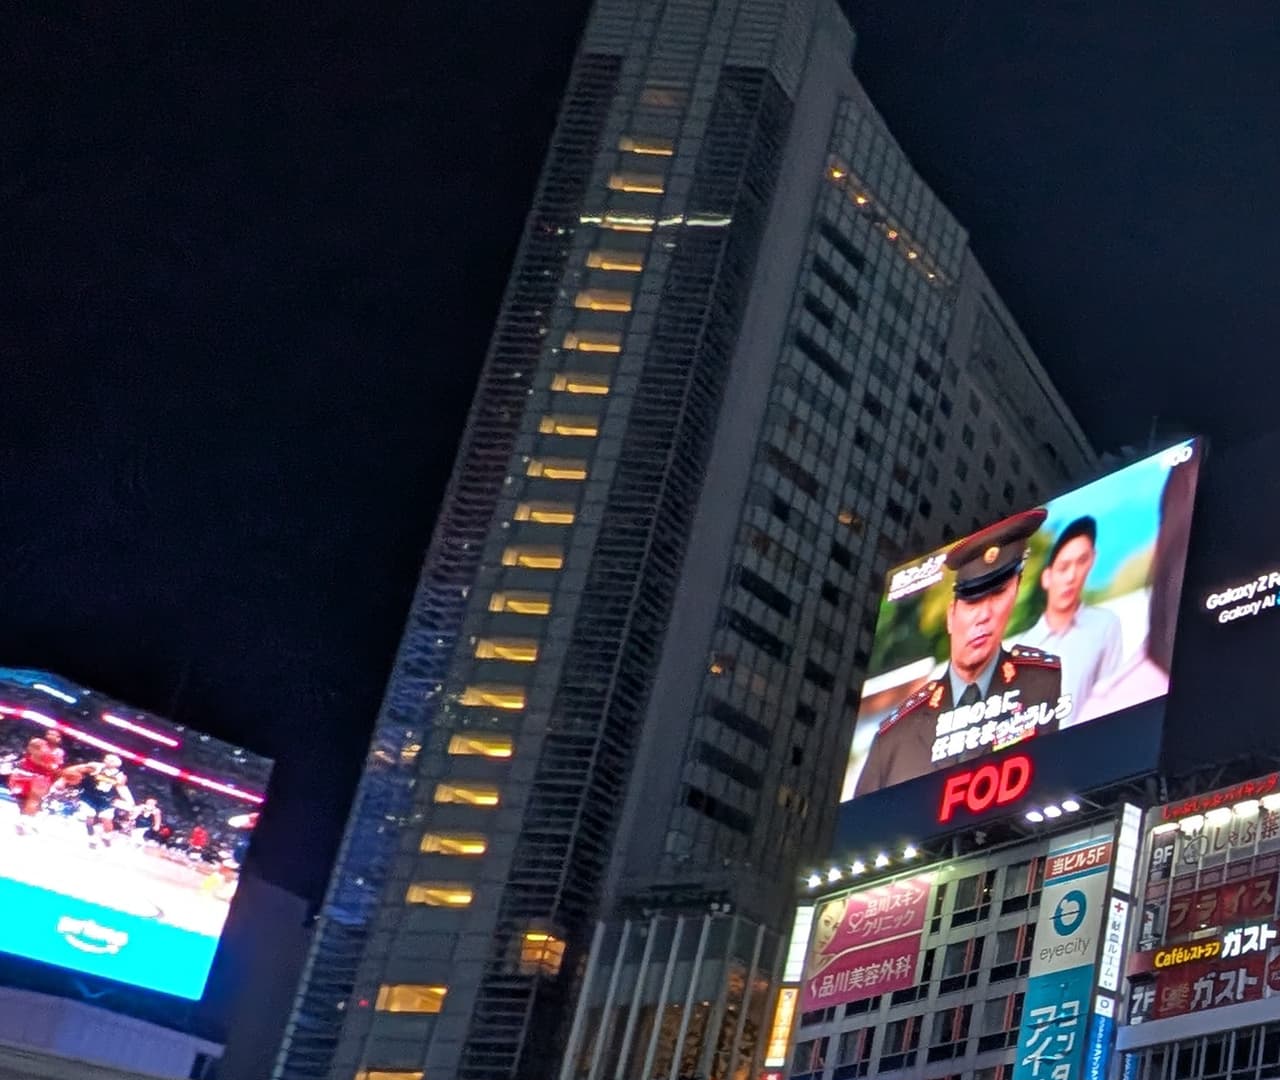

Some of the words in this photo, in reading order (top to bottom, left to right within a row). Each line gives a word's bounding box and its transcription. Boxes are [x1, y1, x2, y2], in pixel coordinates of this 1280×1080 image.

[1206, 581, 1258, 609] Galaxy
[1256, 575, 1279, 592] Z
[1218, 600, 1262, 623] Galaxy
[1262, 594, 1276, 609] AI
[938, 755, 1031, 824] FOD
[1214, 810, 1280, 851] しゃぶ葉
[1051, 846, 1109, 876] 当ビル5F
[1153, 844, 1174, 865] 9F
[861, 907, 916, 938] クリニック
[1039, 935, 1091, 962] eyecity
[1221, 923, 1278, 959] ガスト
[818, 954, 913, 999] 品川美容外科
[1190, 967, 1260, 1012] ガスト
[1131, 990, 1156, 1014] 7F
